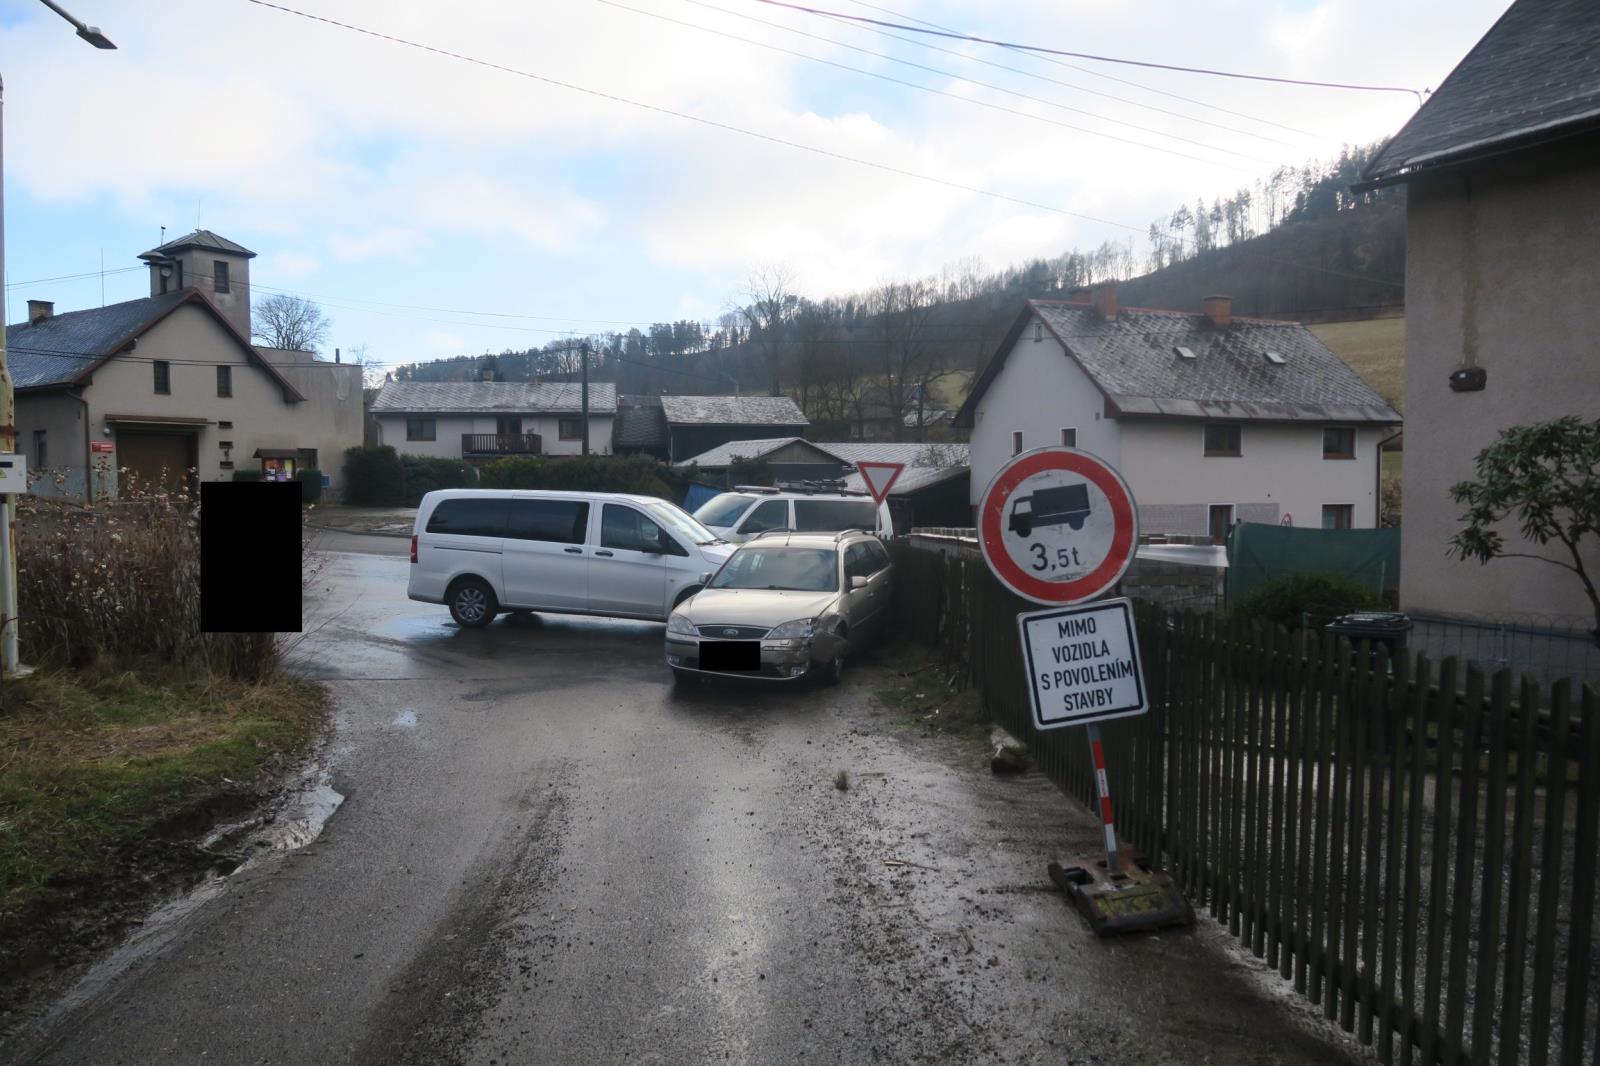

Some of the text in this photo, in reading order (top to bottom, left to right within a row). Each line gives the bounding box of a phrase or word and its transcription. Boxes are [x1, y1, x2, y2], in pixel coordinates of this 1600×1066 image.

[1057, 617, 1096, 639] MIMO
[1051, 639, 1110, 664] VOZIDLA
[1040, 659, 1133, 691] S POVOLENÍM
[1063, 687, 1114, 712] STAVBY
